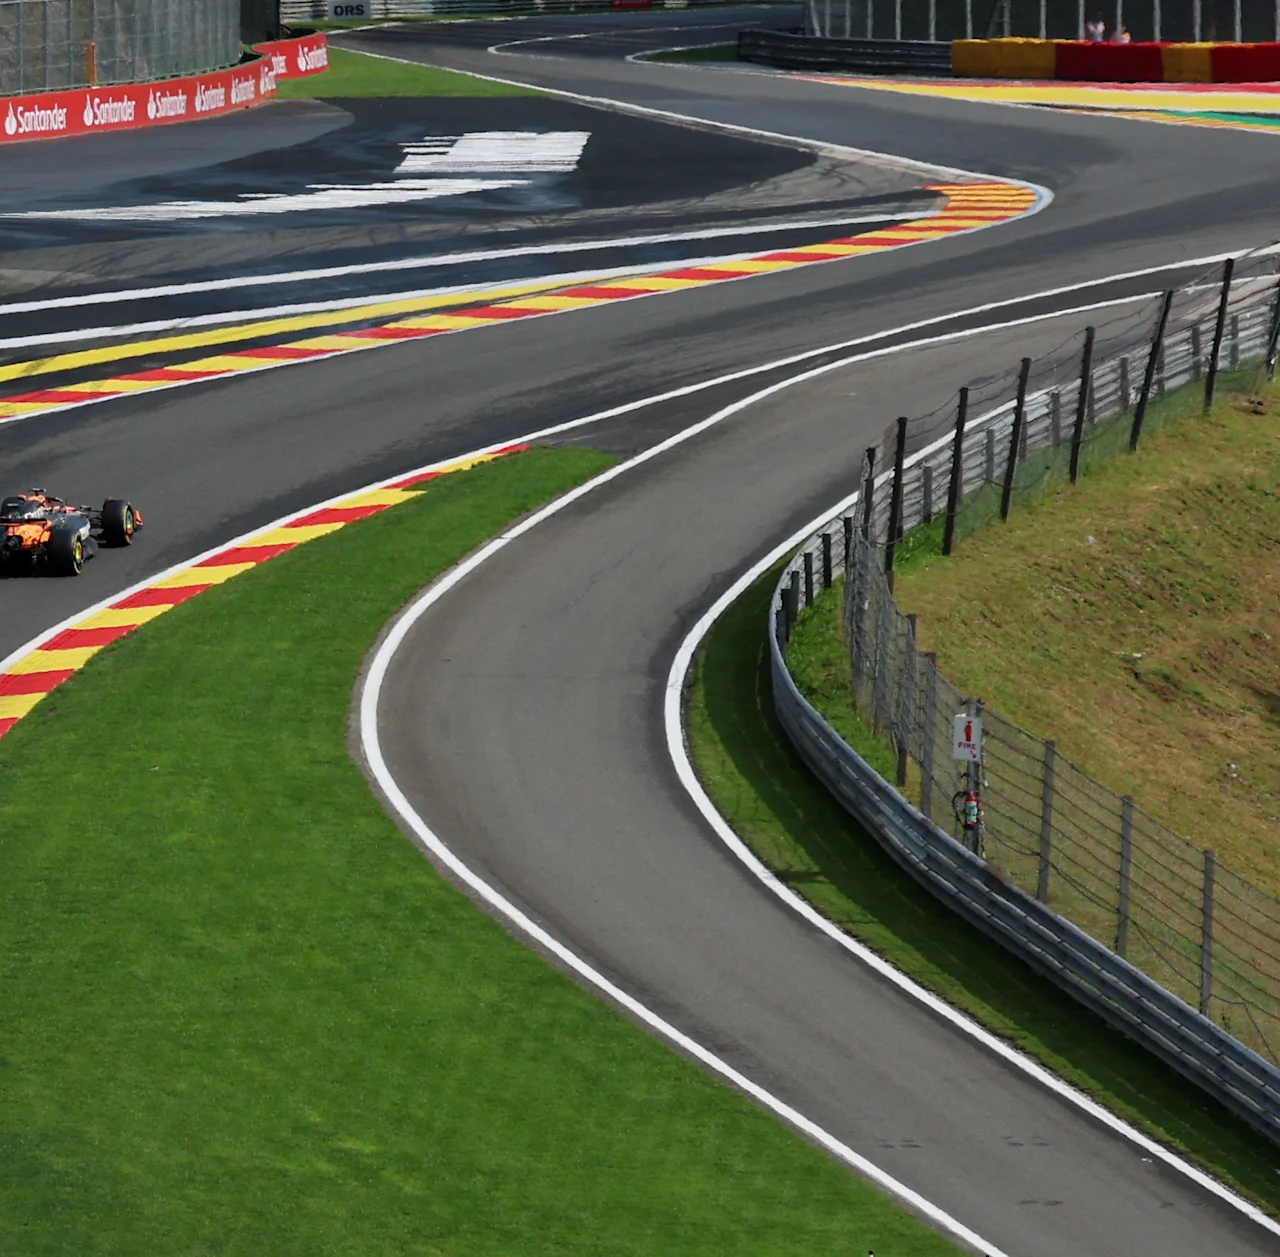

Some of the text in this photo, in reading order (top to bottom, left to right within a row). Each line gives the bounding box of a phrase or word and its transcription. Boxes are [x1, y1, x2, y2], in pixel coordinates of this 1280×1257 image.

[333, 4, 365, 17] DRS
[93, 93, 136, 124] Santander
[155, 89, 188, 118] Santander
[17, 103, 68, 134] Santander
[958, 741, 977, 750] FIRE
